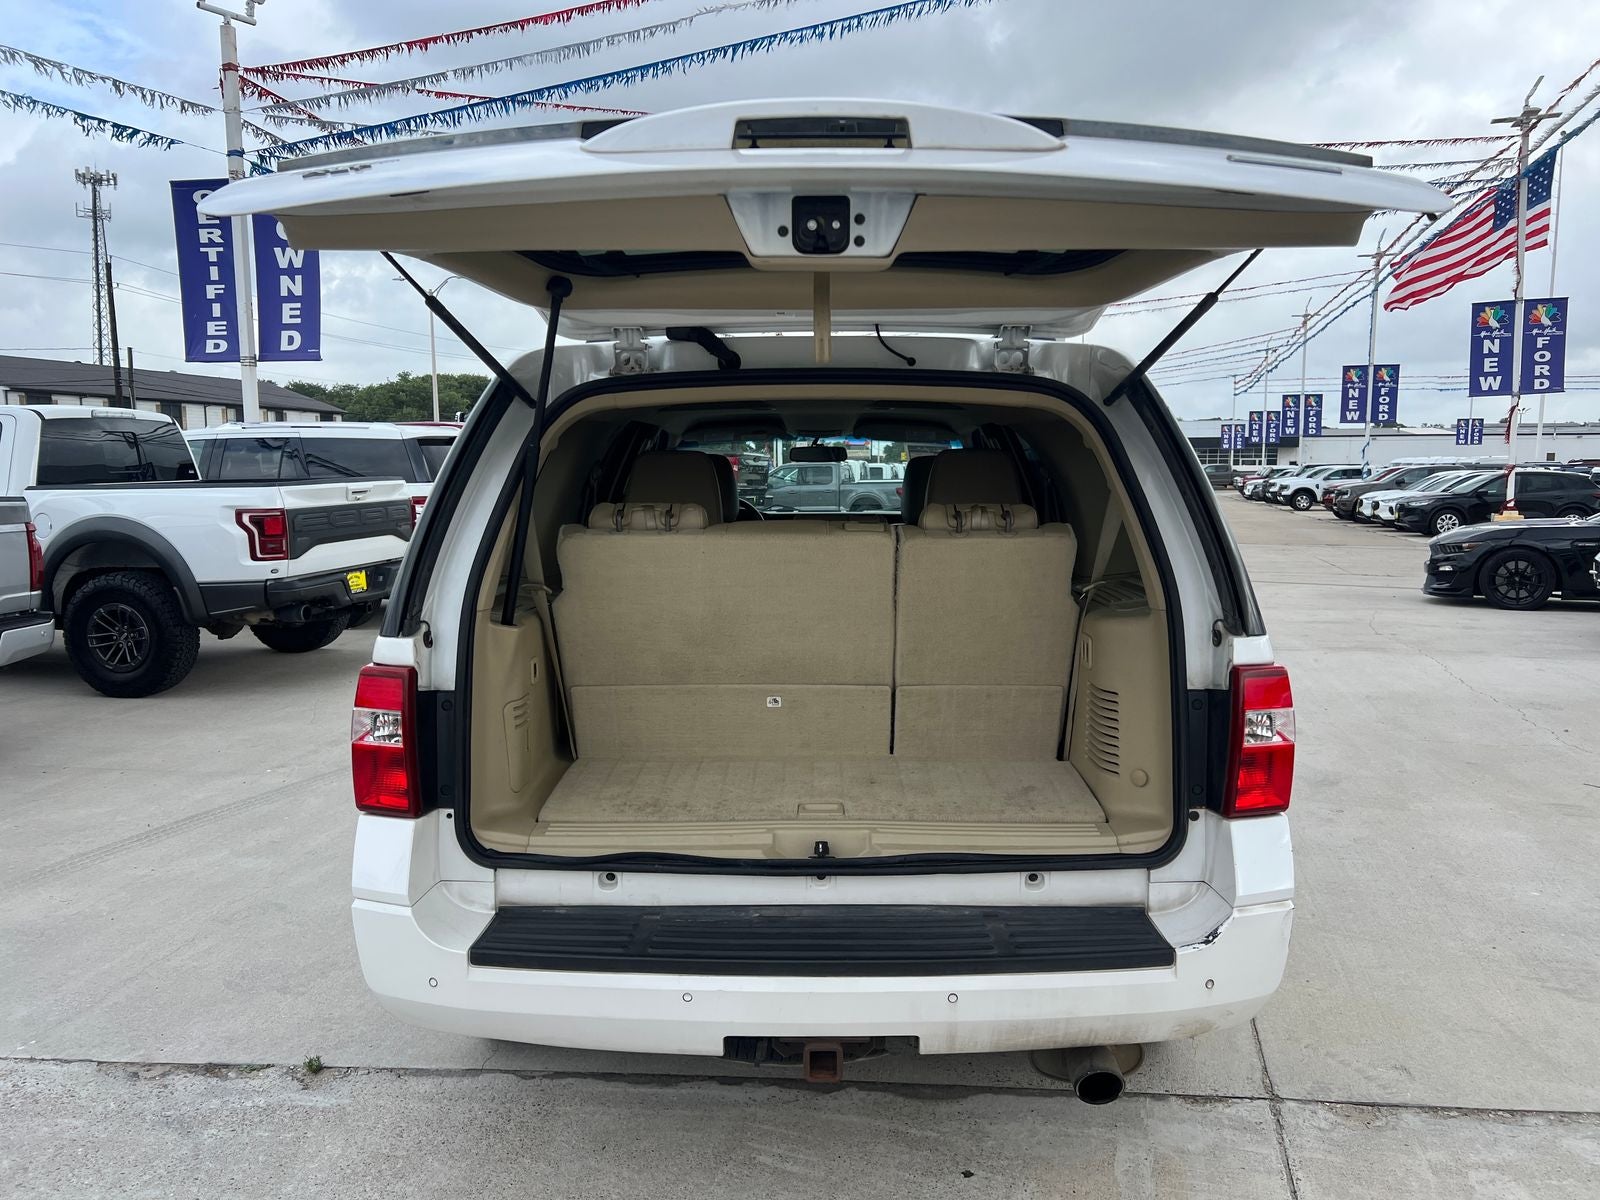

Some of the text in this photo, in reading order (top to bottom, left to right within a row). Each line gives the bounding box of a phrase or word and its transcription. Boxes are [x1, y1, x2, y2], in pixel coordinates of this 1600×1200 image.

[1479, 339, 1502, 390] NEW
[1534, 336, 1551, 389] FORD
[1346, 388, 1360, 420] NEW
[1378, 387, 1390, 420] FORD
[1251, 423, 1260, 443] NEW
[1269, 423, 1277, 443] FORD
[1285, 410, 1296, 434] NEW
[1308, 410, 1317, 434] FORD
